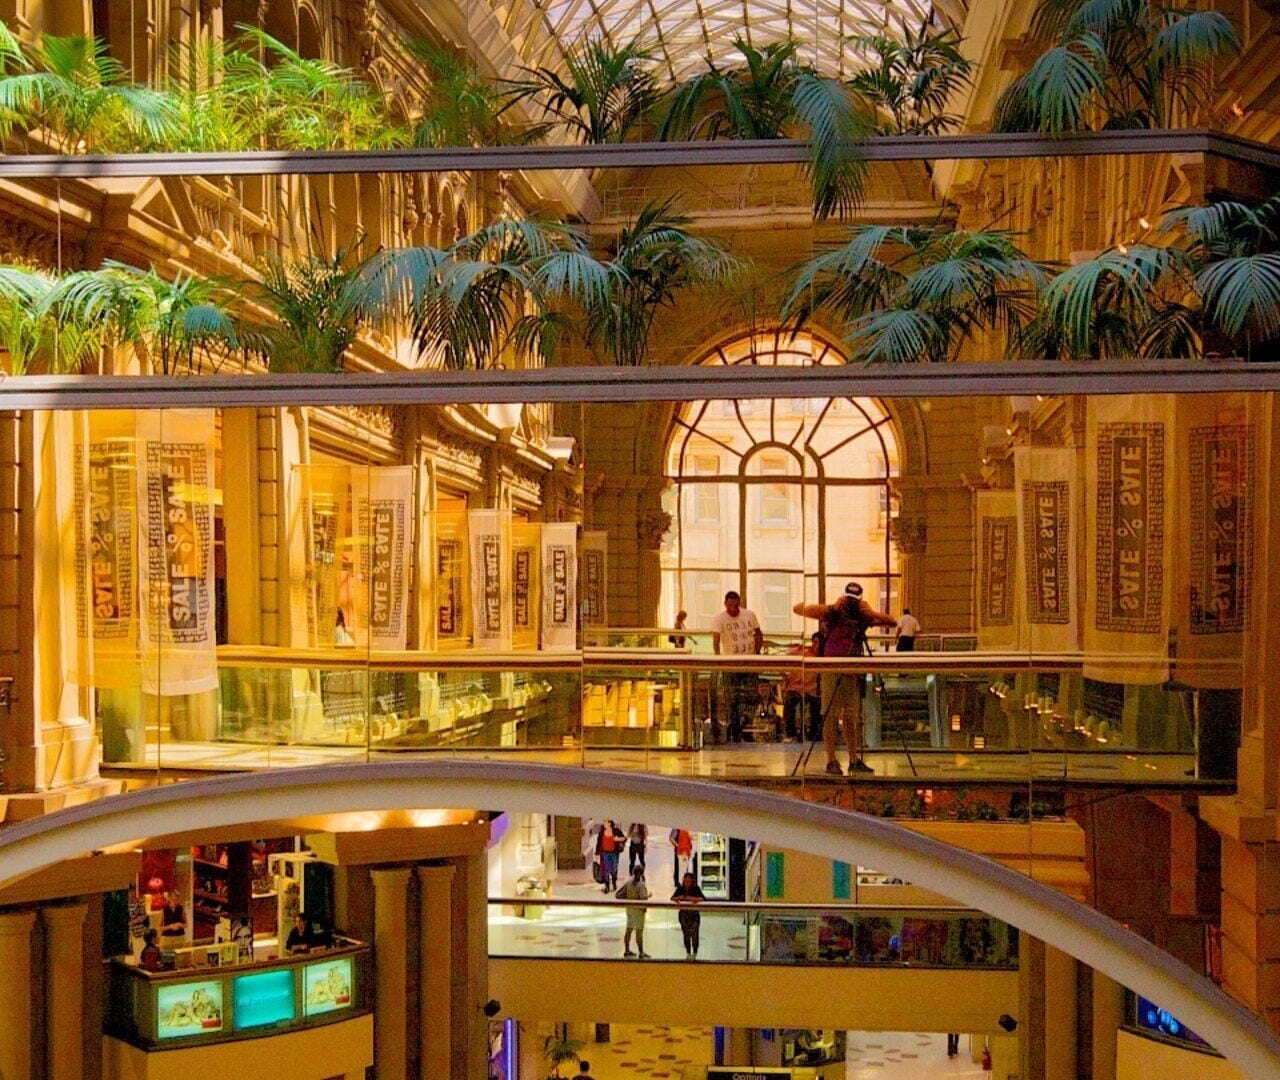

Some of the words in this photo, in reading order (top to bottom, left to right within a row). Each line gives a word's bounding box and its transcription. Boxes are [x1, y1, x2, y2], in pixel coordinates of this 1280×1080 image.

[168, 463, 187, 522] SALE
[168, 534, 192, 552] %
[993, 528, 1005, 561] SALE
[555, 552, 565, 578] SALE
[172, 563, 191, 622] SALE
[555, 594, 565, 620] SALE
[992, 582, 1004, 615] SALE
